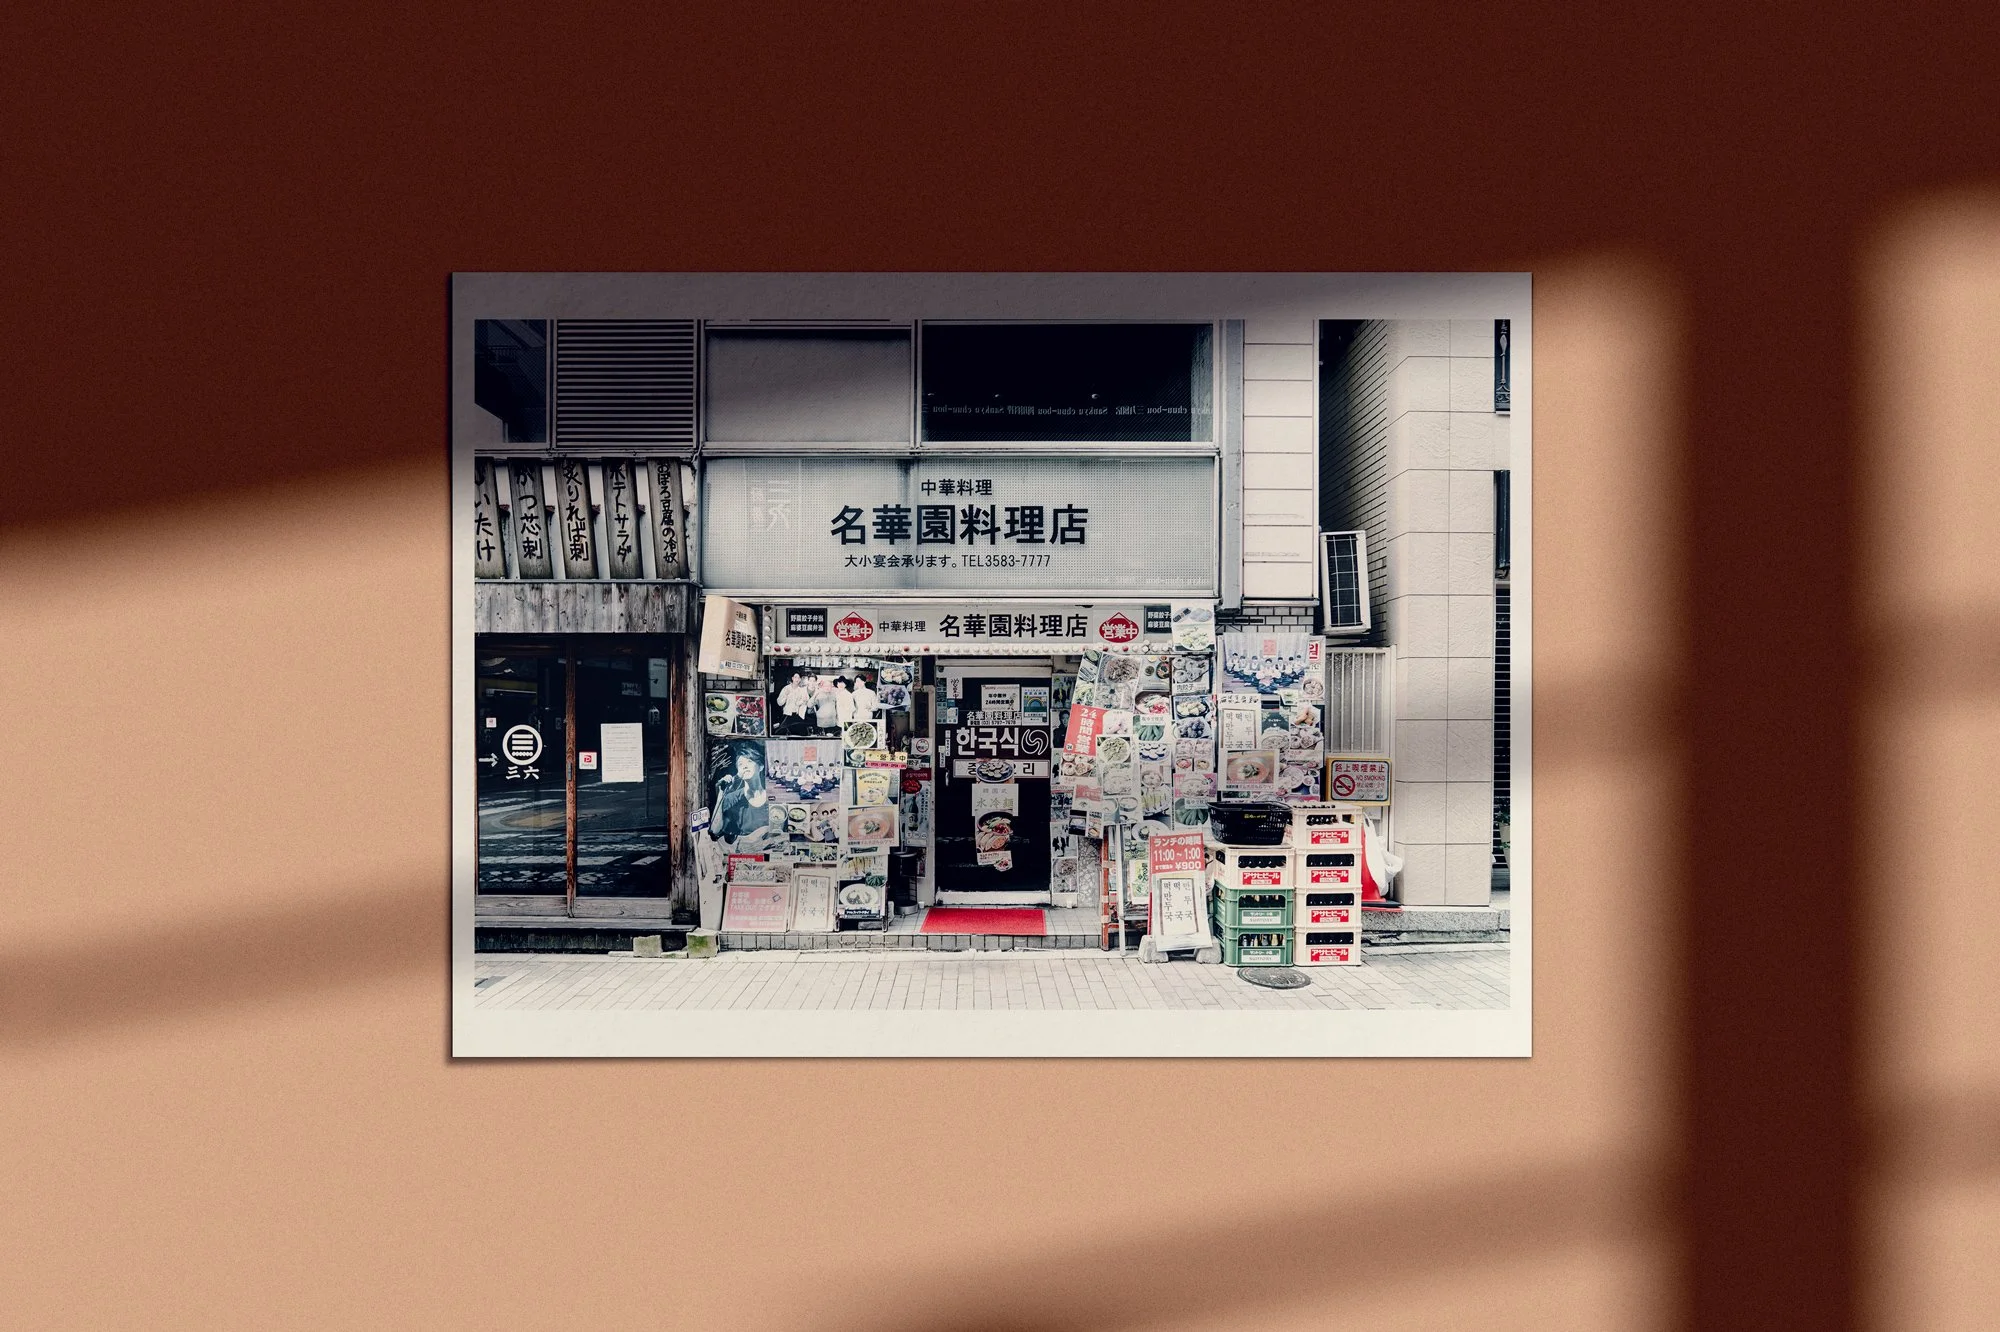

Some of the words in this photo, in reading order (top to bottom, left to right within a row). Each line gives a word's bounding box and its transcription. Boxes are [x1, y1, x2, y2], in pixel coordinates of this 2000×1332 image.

[921, 478, 992, 496] 中華料理
[830, 503, 1089, 546] 名華園料理店
[1147, 611, 1172, 619] 野菜餃子
[836, 620, 872, 639] 営業中
[879, 620, 926, 632] 中華料理
[939, 613, 1088, 638] 名華園料理店
[1102, 622, 1138, 639] 営業中
[956, 727, 1019, 756] 한국식
[505, 765, 540, 780] 三六
[1335, 763, 1385, 773] 路上喫煙禁止
[1311, 830, 1349, 839] アサヒビール
[1154, 849, 1175, 862] 11:00
[1184, 847, 1201, 861] 1:00
[1175, 861, 1202, 870] ¥900
[1243, 872, 1280, 880] アサヒビール
[1311, 869, 1349, 878] アサヒビール
[1311, 909, 1349, 918] アサヒビール
[1311, 948, 1349, 957] アサヒビール
